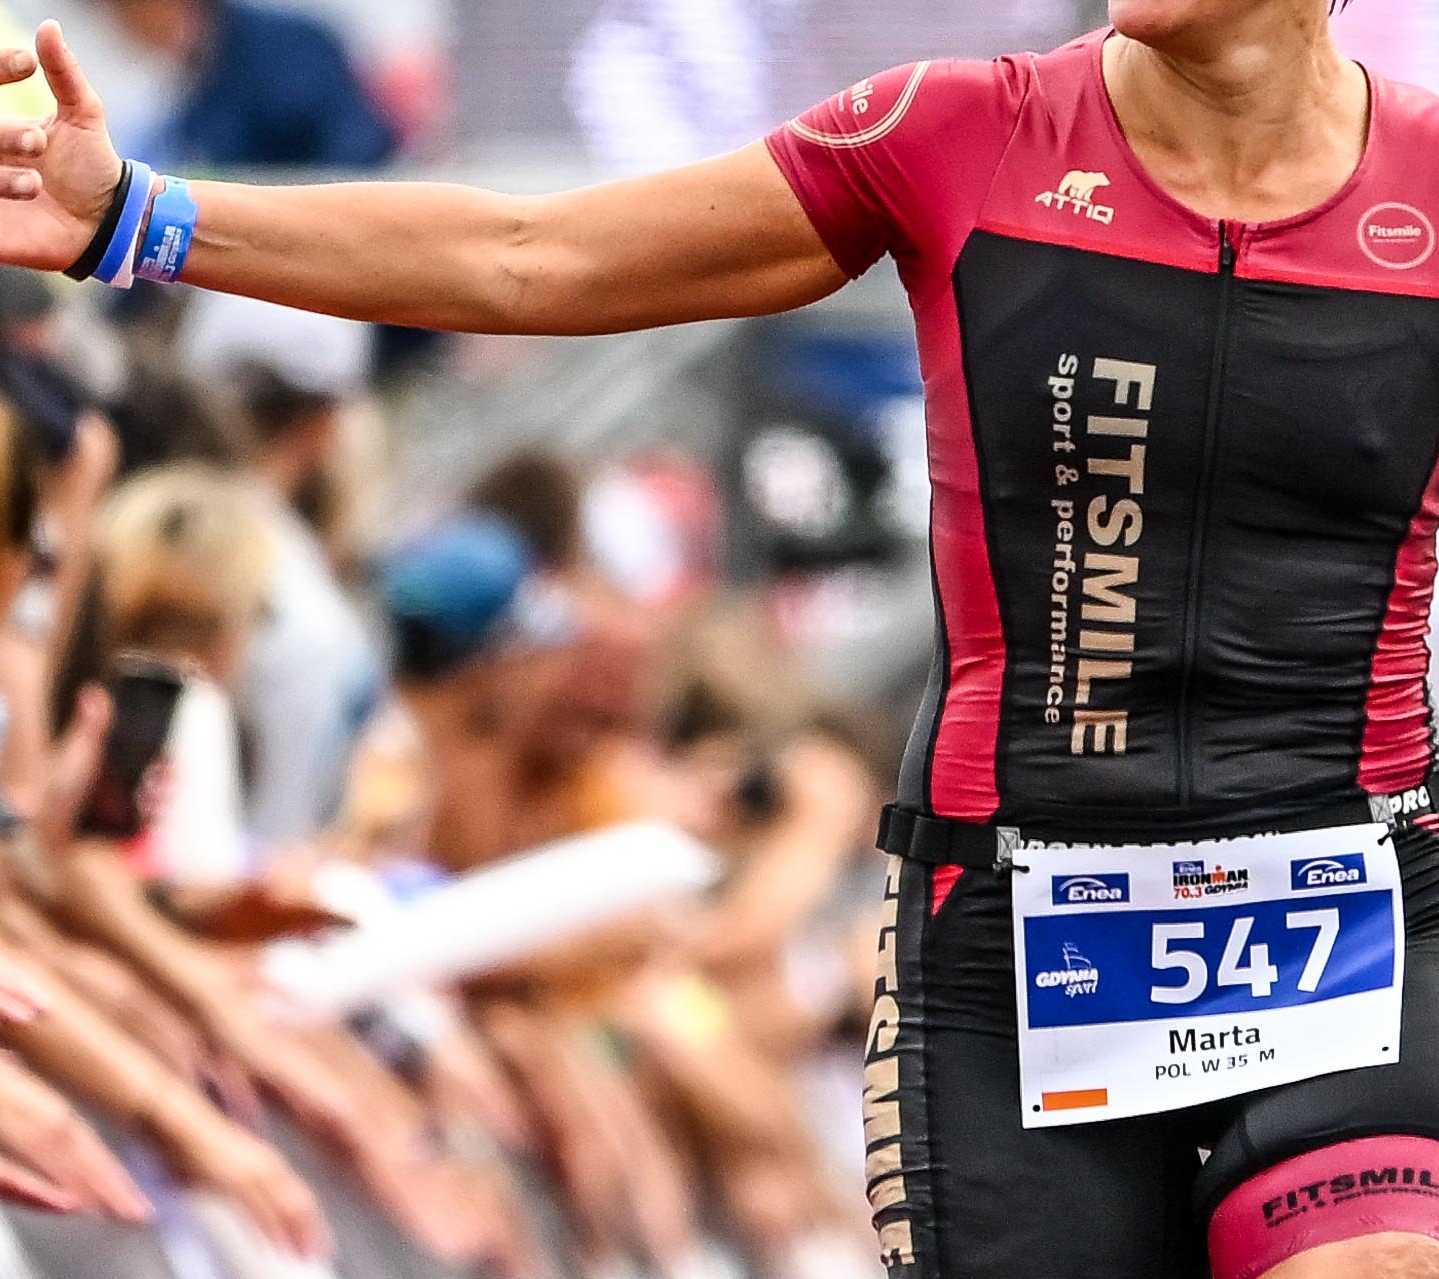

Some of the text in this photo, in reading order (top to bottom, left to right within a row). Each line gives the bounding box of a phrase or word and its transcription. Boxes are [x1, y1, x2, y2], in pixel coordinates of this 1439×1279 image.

[1034, 190, 1115, 225] ATTIQ
[1368, 224, 1422, 238] Fitsmile
[1044, 352, 1080, 724] sport & performance
[1070, 356, 1157, 756] FITSMILE
[1173, 866, 1249, 886] IRONMAN
[1306, 868, 1360, 886] Enea
[1067, 885, 1122, 902] Enea
[1150, 906, 1340, 1005] 547
[1035, 967, 1099, 988] GDYNIA
[1168, 1025, 1261, 1055] Marta
[1155, 1048, 1276, 1081] POL W 35 M
